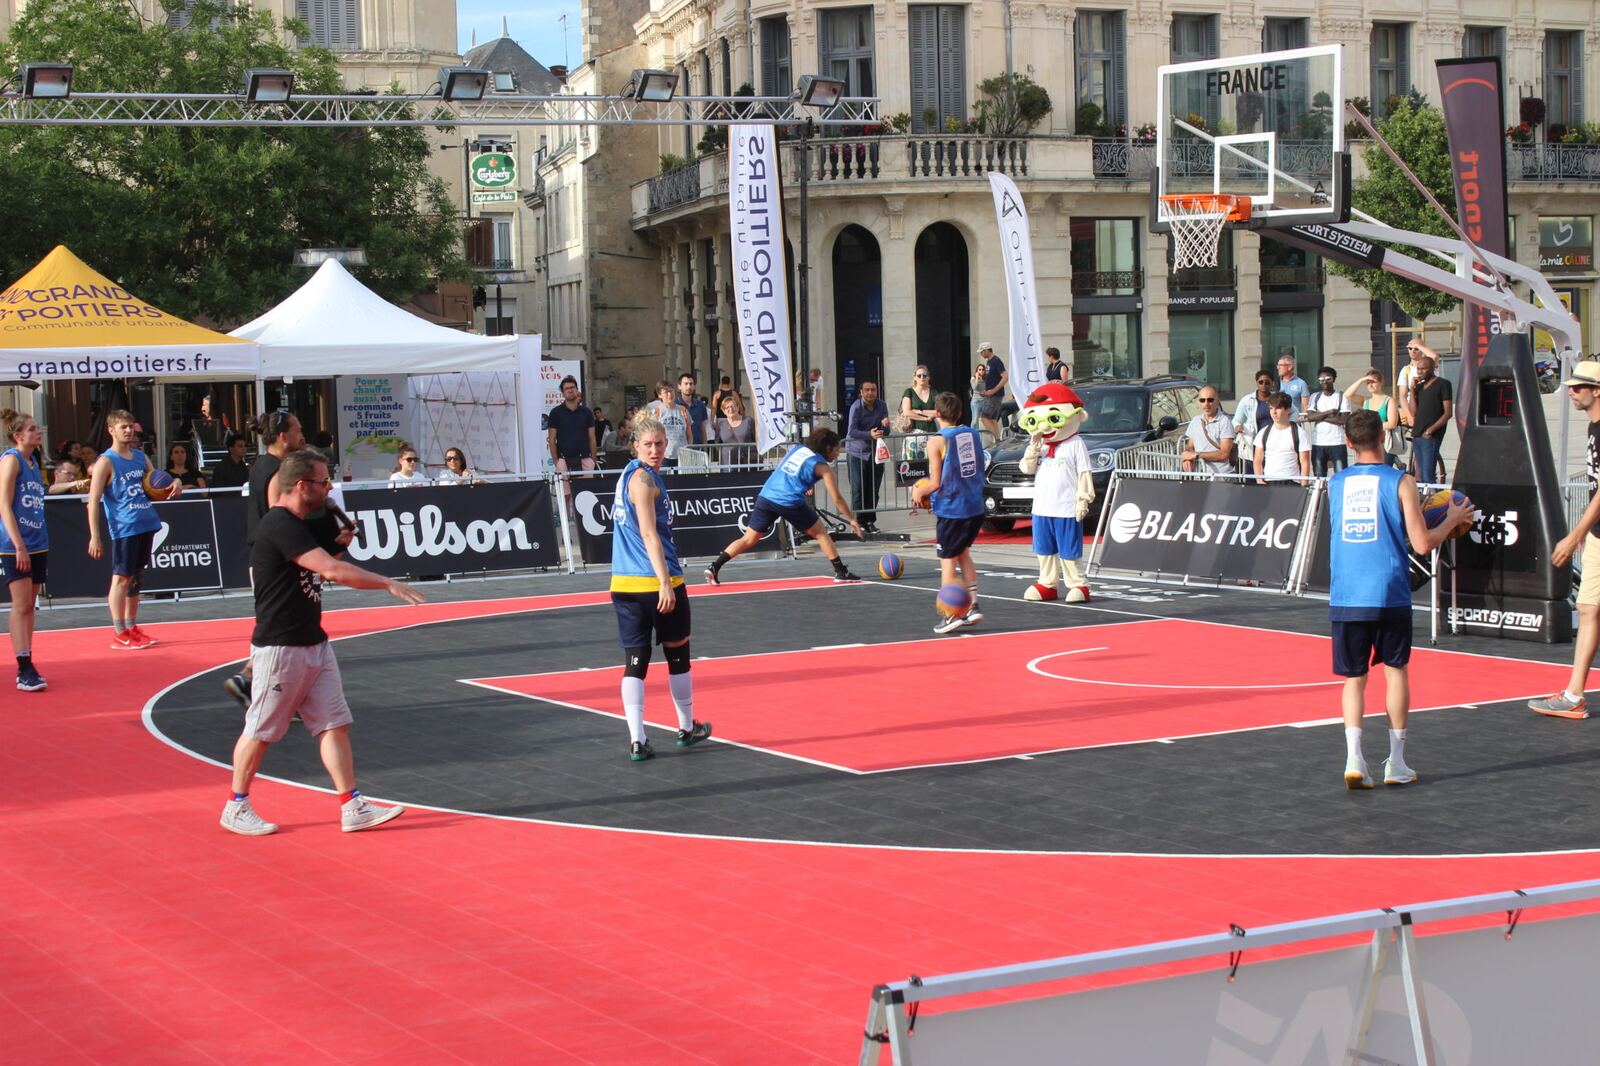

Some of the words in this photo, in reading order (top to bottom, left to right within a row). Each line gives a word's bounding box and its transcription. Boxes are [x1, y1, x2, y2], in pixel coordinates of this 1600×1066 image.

[1206, 65, 1286, 96] FRANCE
[477, 167, 511, 183] Carlsberg
[1298, 224, 1373, 254] ORTSYSTEM
[28, 285, 132, 304] GRAND
[1200, 296, 1235, 304] POPULAIRE
[18, 303, 163, 321] POITIERS
[4, 319, 121, 332] communauté
[126, 319, 189, 328] urbaine
[18, 353, 211, 379] grandpoitiers.fr
[355, 377, 376, 385] Pour
[353, 385, 392, 394] chauffer
[344, 402, 403, 411] recommande
[357, 411, 362, 419] 5
[365, 411, 391, 419] fruits
[349, 420, 359, 428] et
[361, 419, 400, 430] légumes
[357, 430, 372, 438] par
[374, 428, 397, 438] jour.
[347, 504, 533, 561] Wilson
[1138, 510, 1299, 549] BLASTRAC
[1344, 522, 1375, 534] GRDF
[171, 543, 210, 551] DÉPARTEMENT
[150, 550, 212, 569] ienne
[1447, 607, 1543, 628] SPORTSYSTEM
